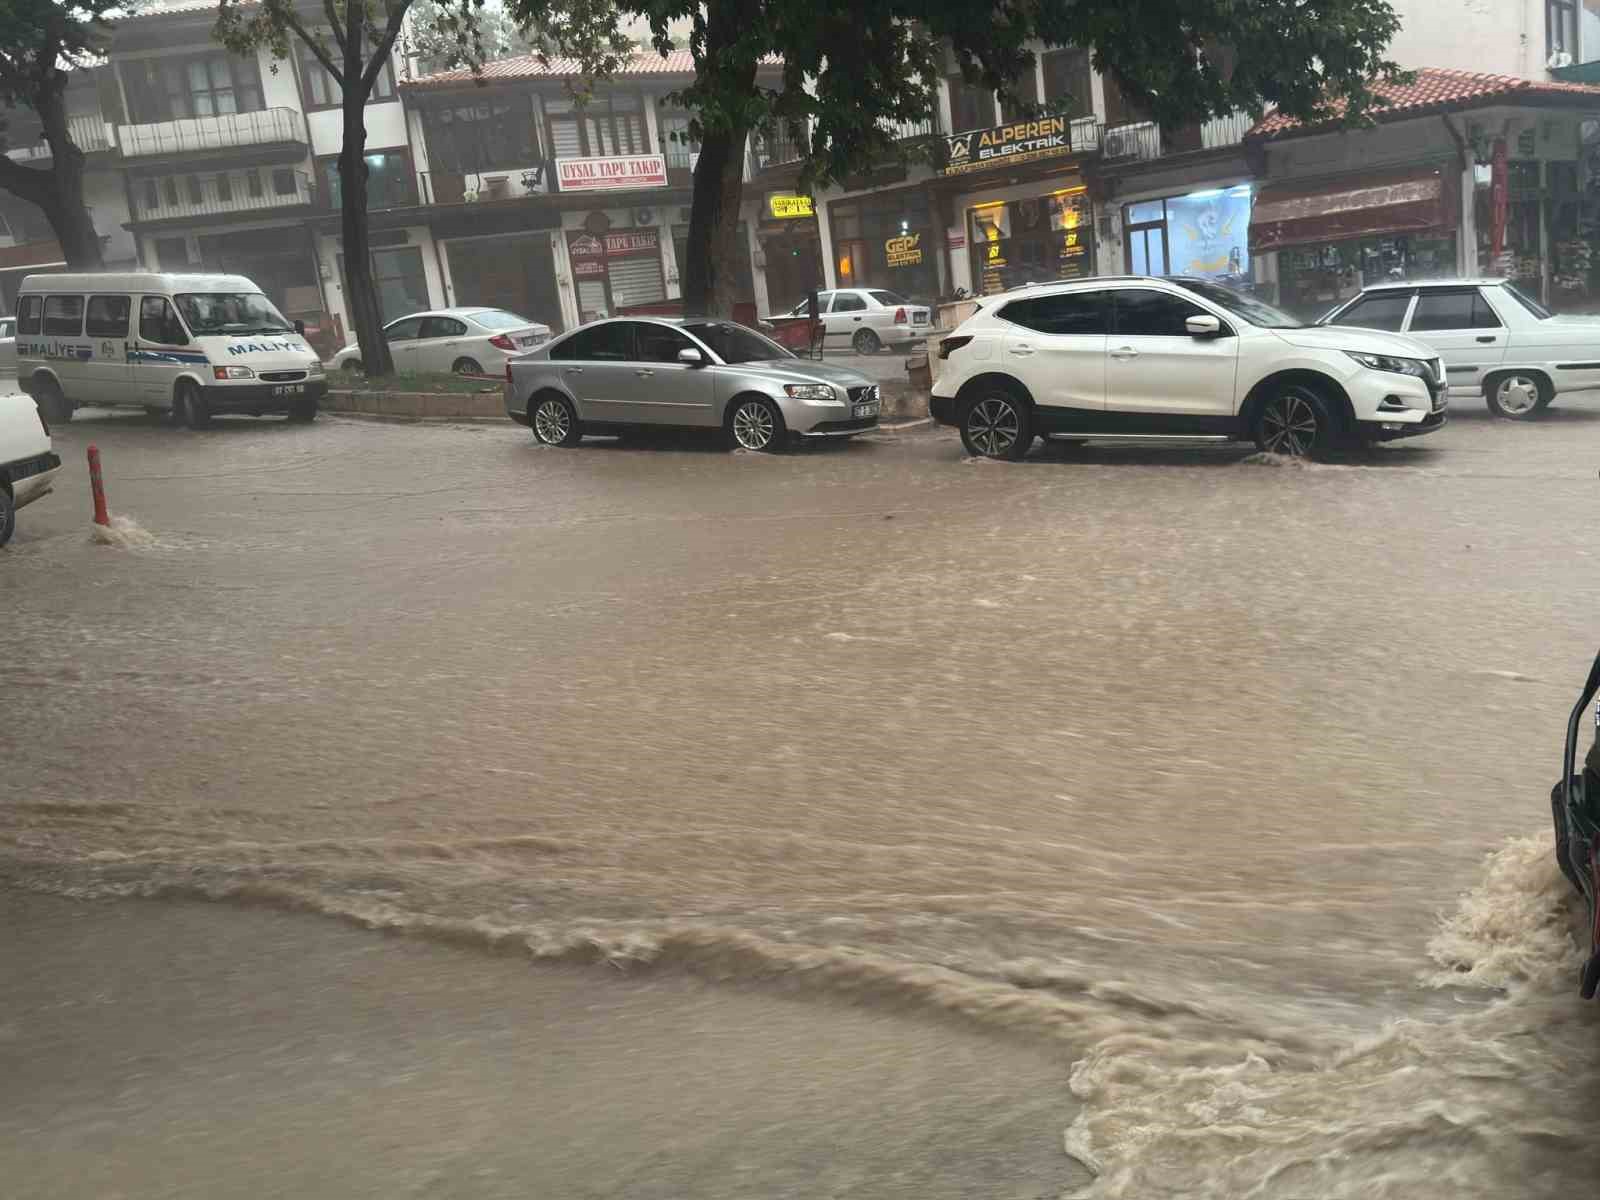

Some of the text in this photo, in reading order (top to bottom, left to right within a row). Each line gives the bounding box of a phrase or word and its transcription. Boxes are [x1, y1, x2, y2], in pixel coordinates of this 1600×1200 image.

[979, 117, 1065, 148] ALPEREN
[979, 134, 1065, 160] ELEKTRİK
[562, 163, 596, 179] UYSAL
[599, 161, 626, 178] TAPU
